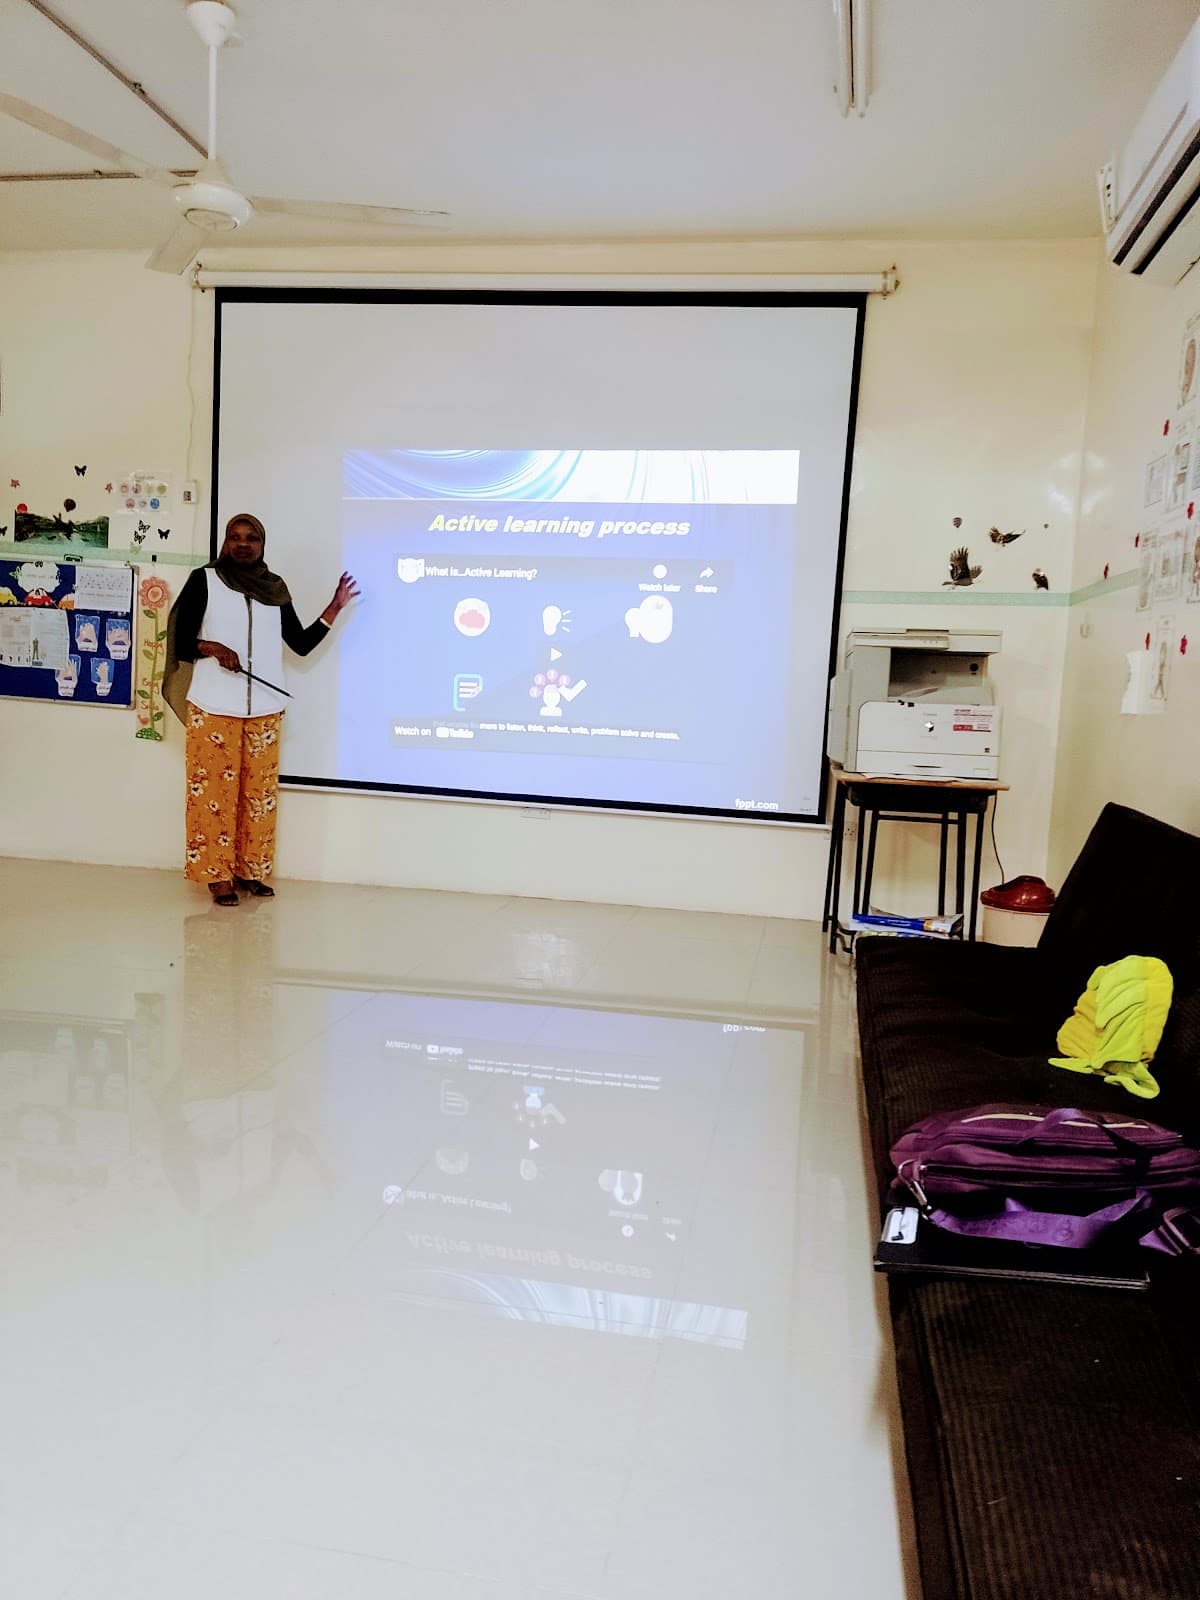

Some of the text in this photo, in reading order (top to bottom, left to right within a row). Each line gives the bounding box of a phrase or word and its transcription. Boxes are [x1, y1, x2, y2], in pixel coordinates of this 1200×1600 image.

[428, 514, 691, 538] Active learning process
[425, 566, 449, 577] What
[394, 725, 420, 736] Watch
[420, 728, 432, 737] on
[590, 727, 620, 737] problem
[620, 729, 640, 738] solve
[640, 730, 655, 739] and
[735, 798, 780, 810] fppt.com
